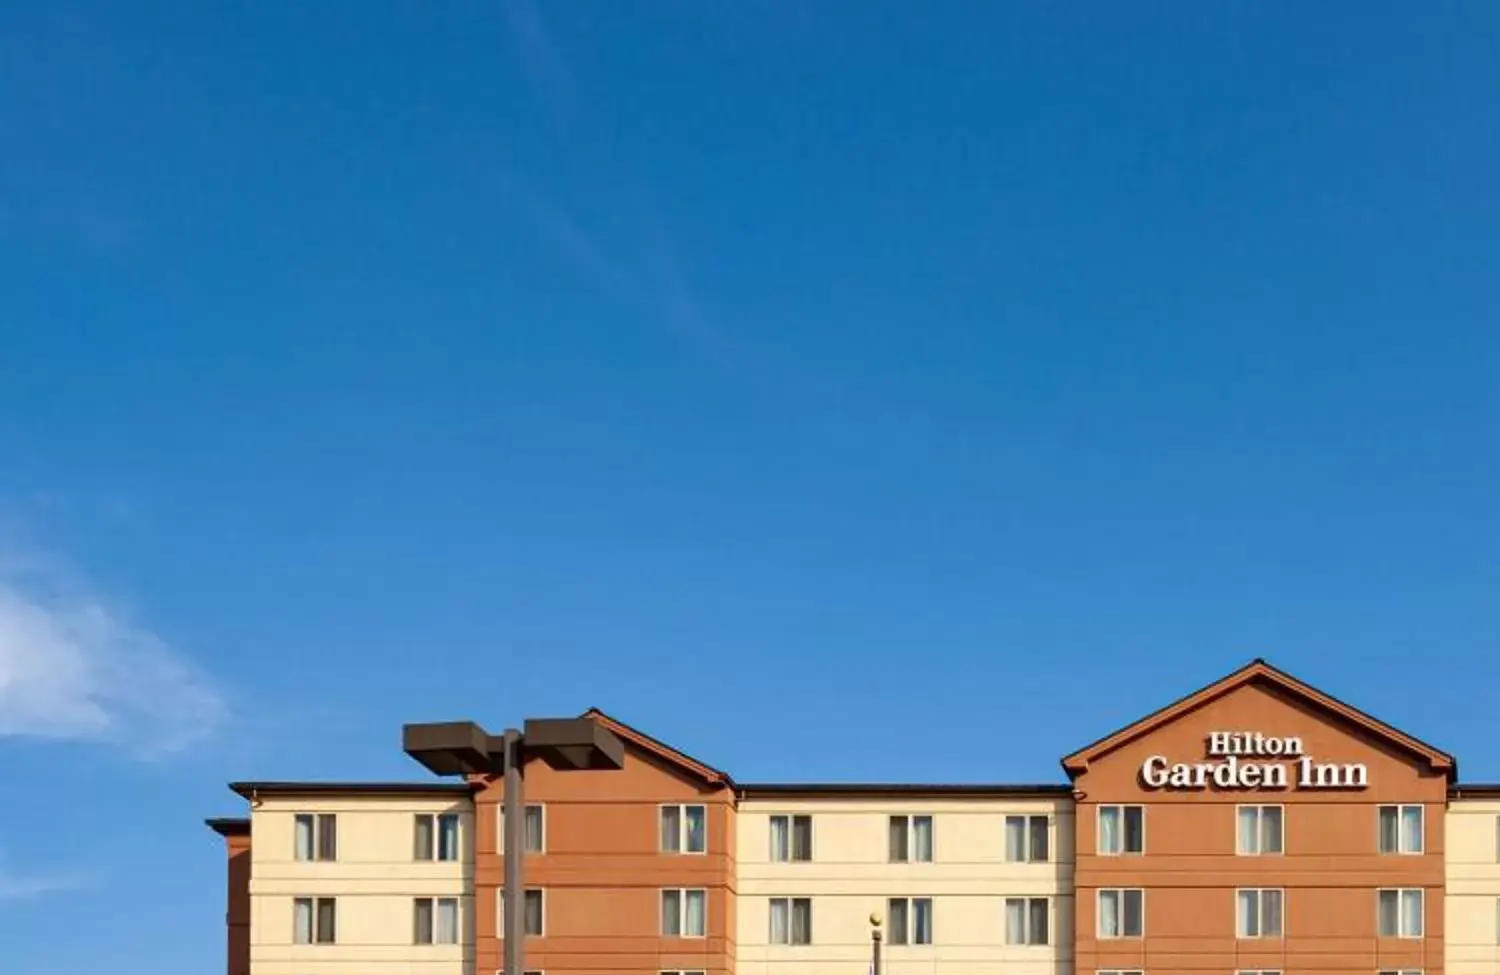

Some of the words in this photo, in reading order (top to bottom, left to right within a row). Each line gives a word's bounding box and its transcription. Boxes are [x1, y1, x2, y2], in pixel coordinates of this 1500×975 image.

[1208, 731, 1303, 754] Hilton
[1141, 755, 1288, 788] Garden
[1298, 755, 1368, 787] Inn
